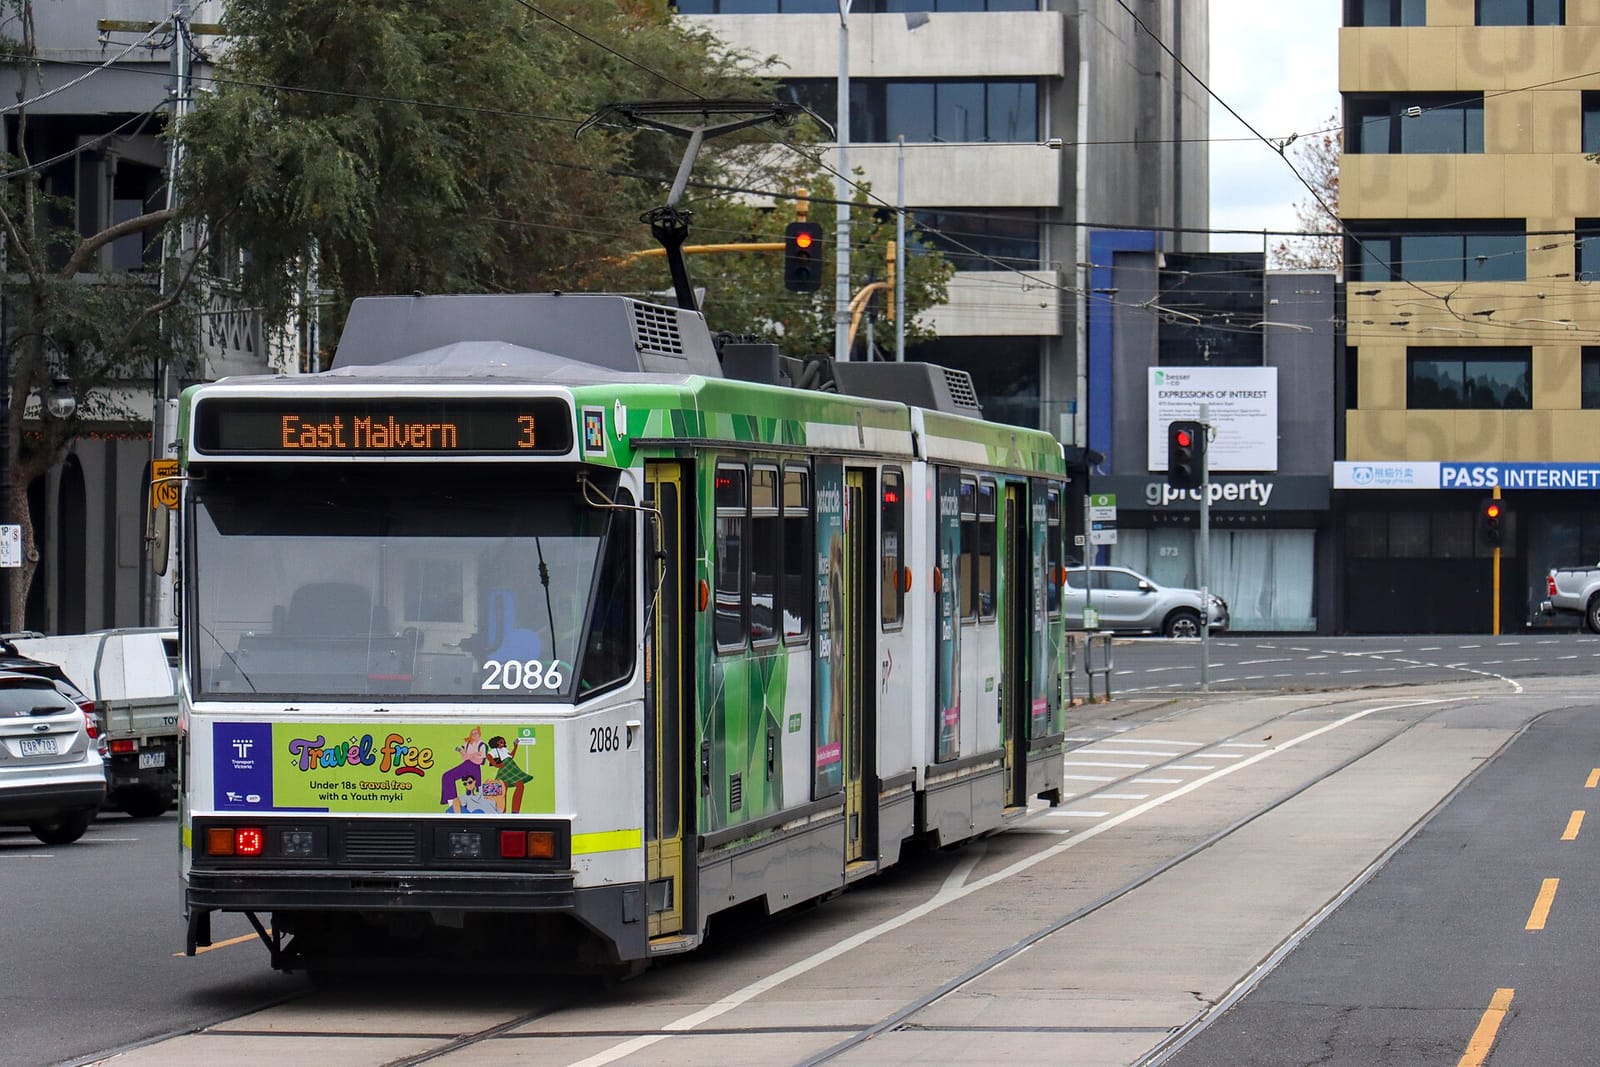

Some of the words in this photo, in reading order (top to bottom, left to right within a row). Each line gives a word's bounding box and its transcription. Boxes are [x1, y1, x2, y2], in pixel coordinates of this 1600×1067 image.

[1158, 390, 1214, 399] EXPRESSIONS
[1216, 390, 1227, 399] OF
[1229, 390, 1268, 399] INTEREST
[282, 415, 346, 448] East
[353, 415, 457, 448] Malvern
[518, 415, 535, 448] 3
[1442, 467, 1499, 487] PASS
[1504, 469, 1600, 487] INTERNET
[1208, 514, 1267, 522] nvest
[1160, 547, 1178, 557] 873
[481, 659, 563, 690] 2086
[163, 715, 178, 726] TOY
[589, 726, 620, 754] 2086
[289, 734, 376, 772] Travel
[379, 733, 435, 773] free
[309, 781, 339, 790] Under
[341, 781, 357, 790] 18s
[359, 780, 390, 791] travel
[390, 780, 413, 791] free
[318, 792, 339, 801] with
[350, 792, 378, 801] Youth
[380, 792, 403, 803] myki
